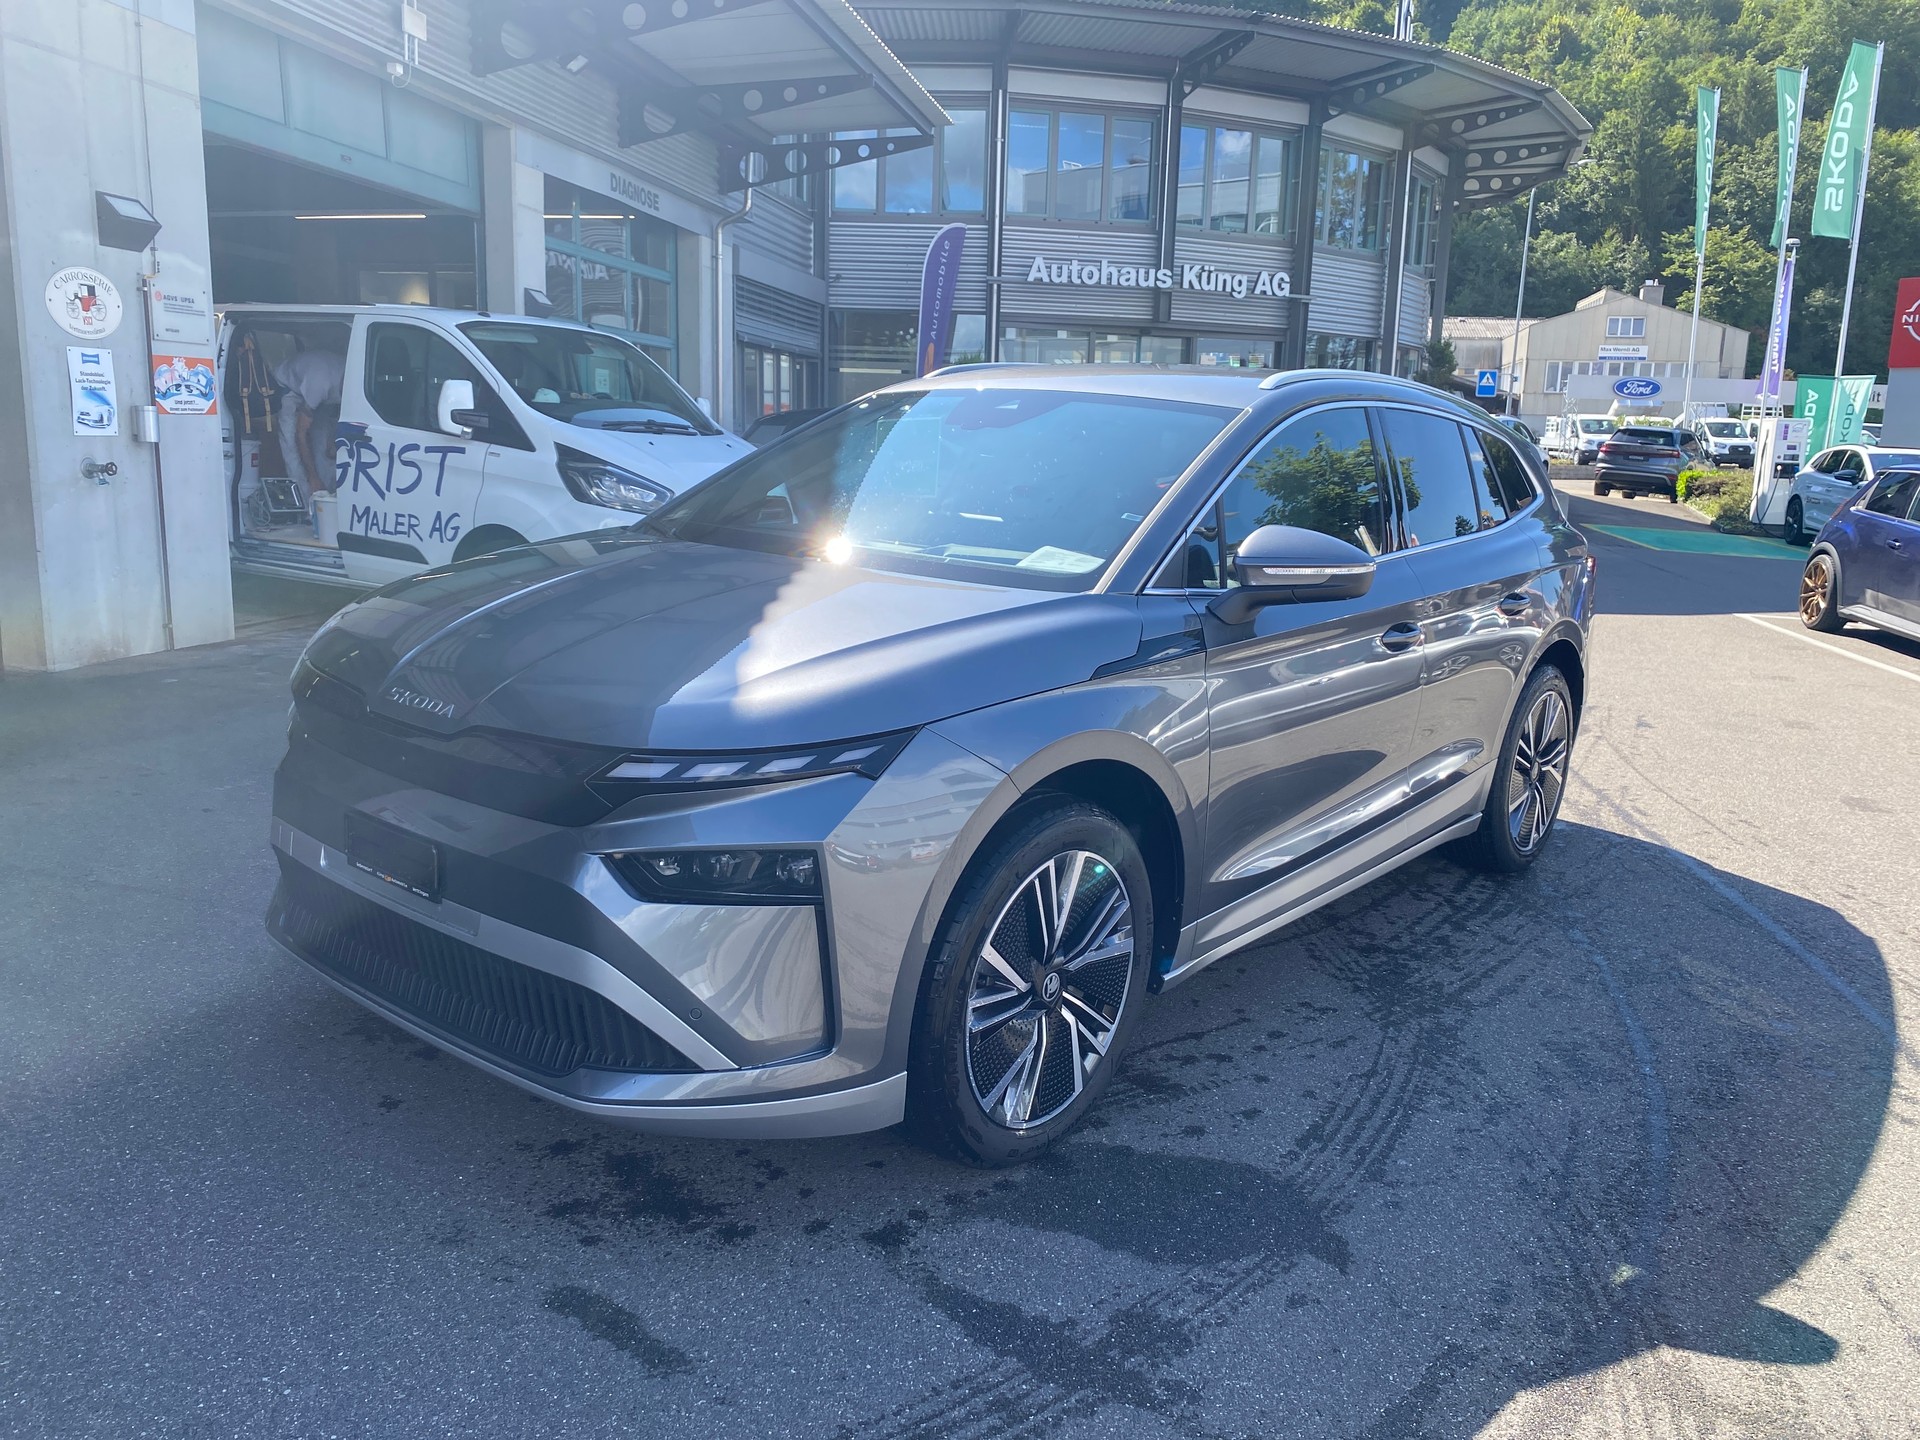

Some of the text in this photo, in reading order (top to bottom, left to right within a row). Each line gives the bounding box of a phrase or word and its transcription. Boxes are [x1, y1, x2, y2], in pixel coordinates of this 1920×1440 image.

[609, 172, 660, 212] DIAGNOSE
[53, 271, 114, 296] CARROSSERIE
[930, 240, 951, 340] Automobile
[1027, 257, 1291, 299] Autohaus Küng AG
[1902, 314, 1920, 323] NI
[1623, 380, 1654, 395] Ford
[1839, 390, 1859, 443] KODA
[336, 438, 466, 501] GRIST
[350, 504, 460, 543] MALER AG
